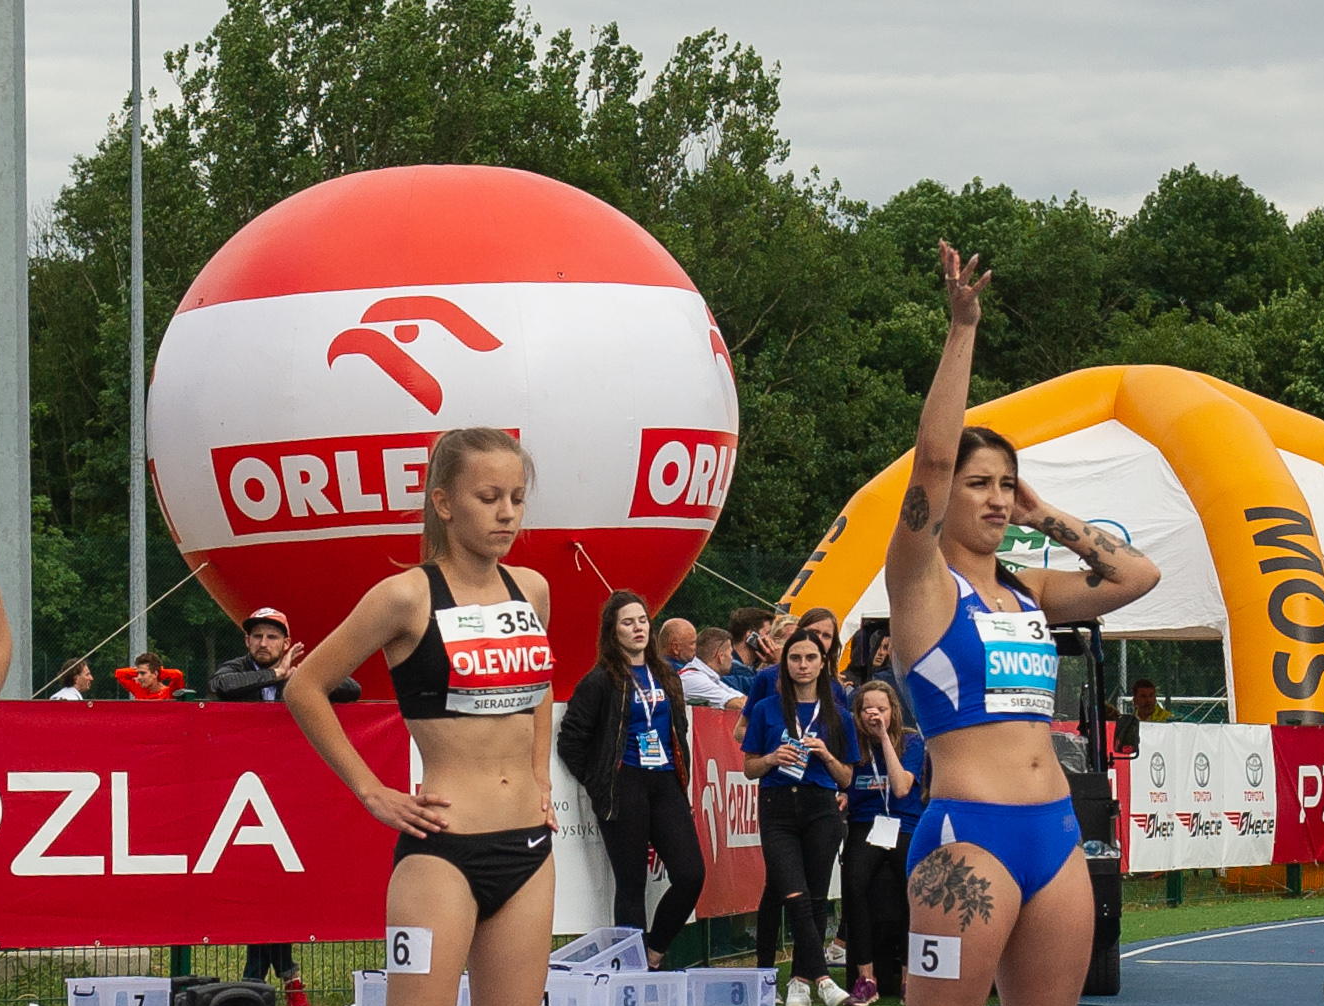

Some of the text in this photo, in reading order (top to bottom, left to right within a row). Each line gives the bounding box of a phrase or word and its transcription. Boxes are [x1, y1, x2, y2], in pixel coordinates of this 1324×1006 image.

[229, 446, 428, 521] ORLE
[648, 441, 736, 508] ORL
[497, 610, 541, 634] 354
[452, 645, 554, 676] OLEWICZ
[474, 697, 515, 710] SIERADZ
[729, 783, 759, 835] ORLE
[921, 940, 939, 972] 5
